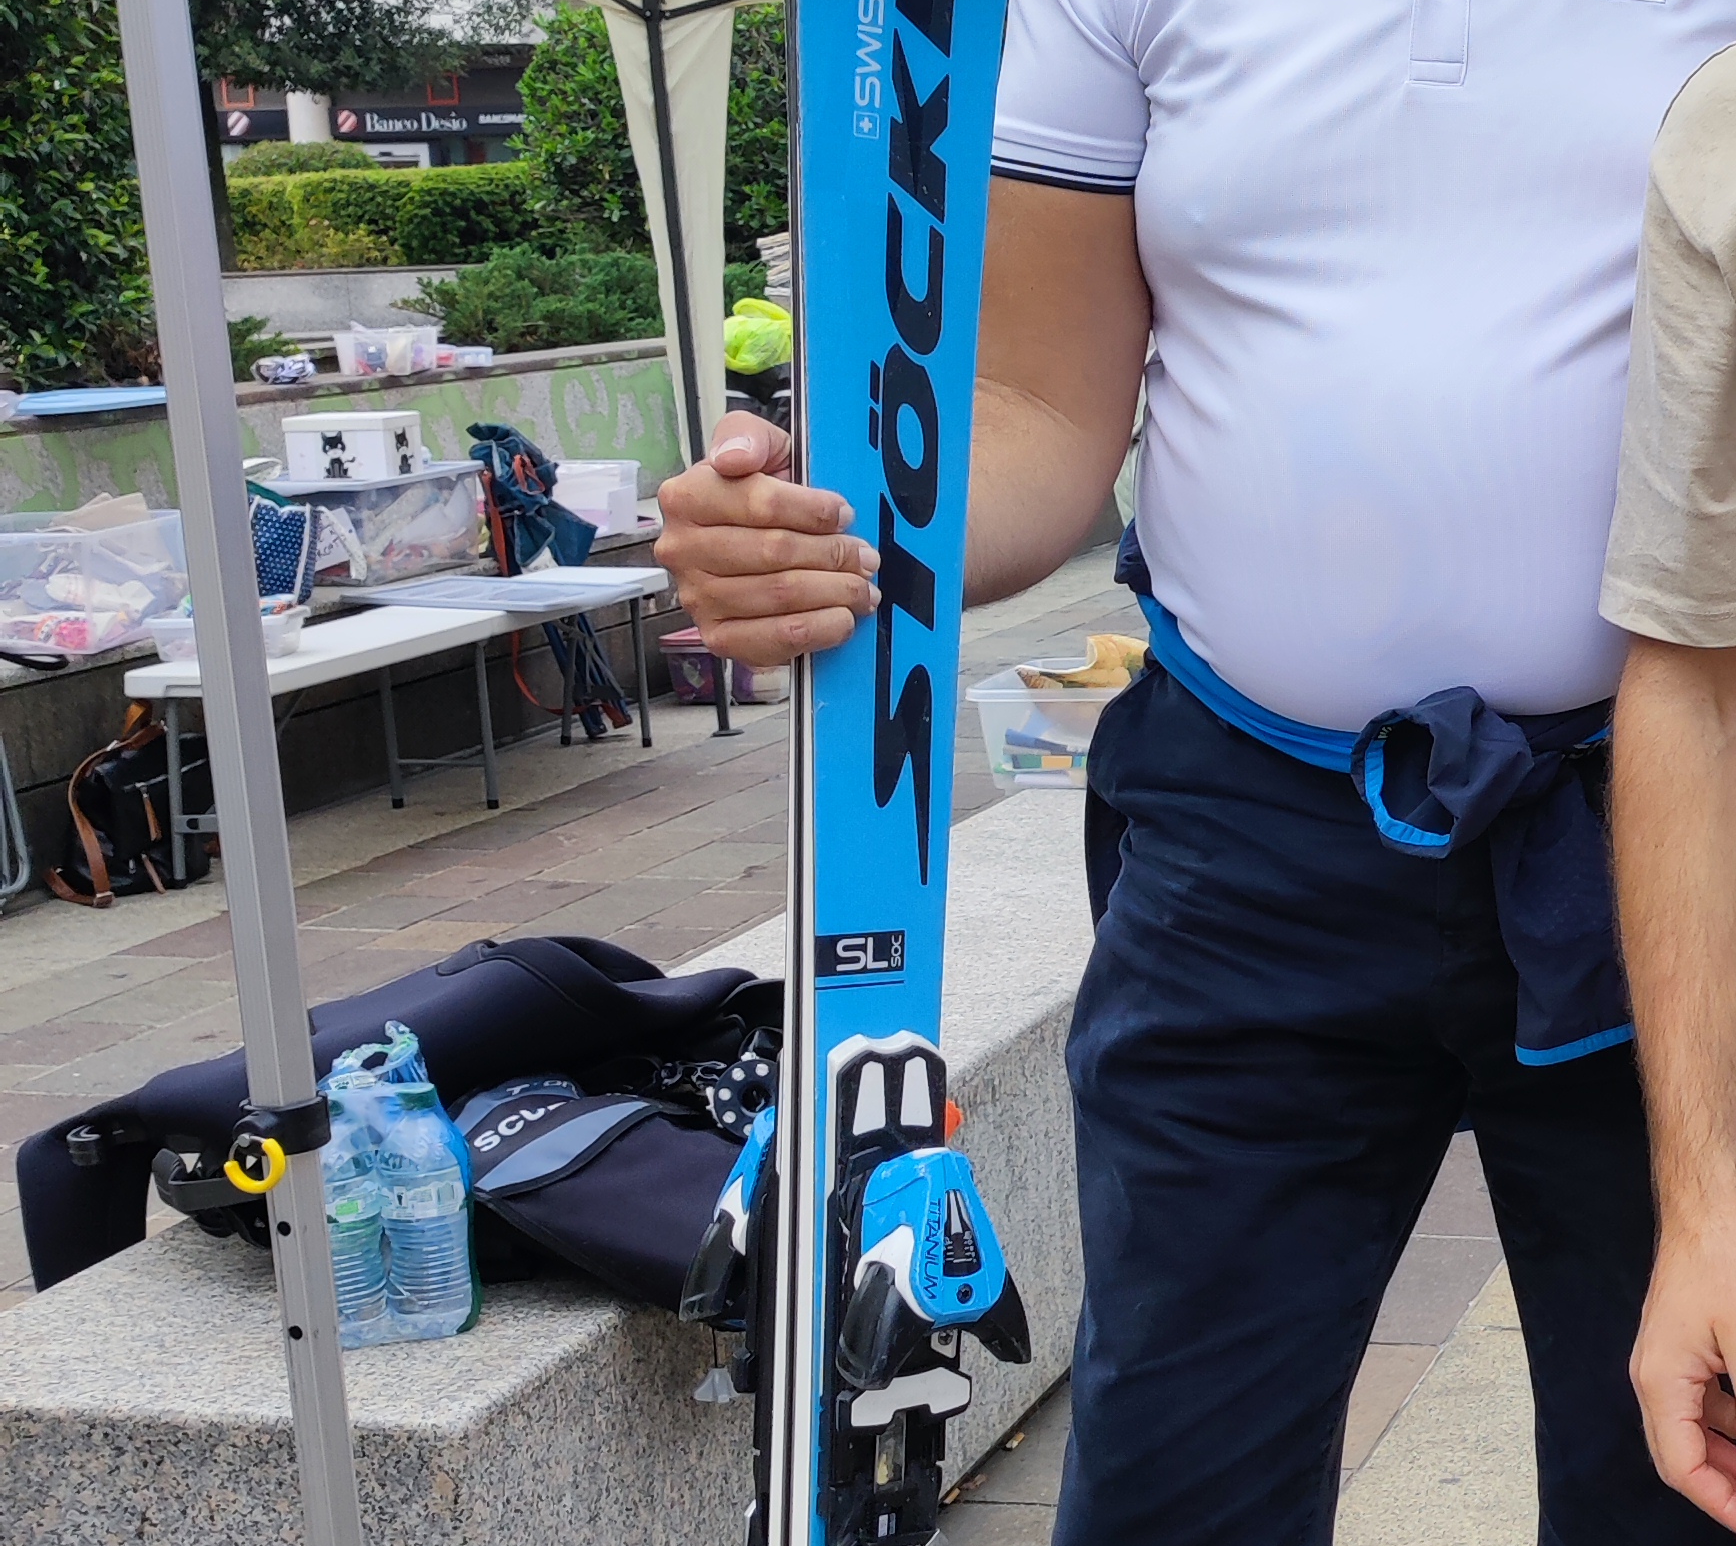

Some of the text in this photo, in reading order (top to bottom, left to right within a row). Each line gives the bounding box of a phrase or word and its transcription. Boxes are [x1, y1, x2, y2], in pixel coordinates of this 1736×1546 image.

[364, 109, 468, 133] Banco Desio
[836, 936, 889, 972] SL
[922, 1197, 943, 1301] TITANIUM
